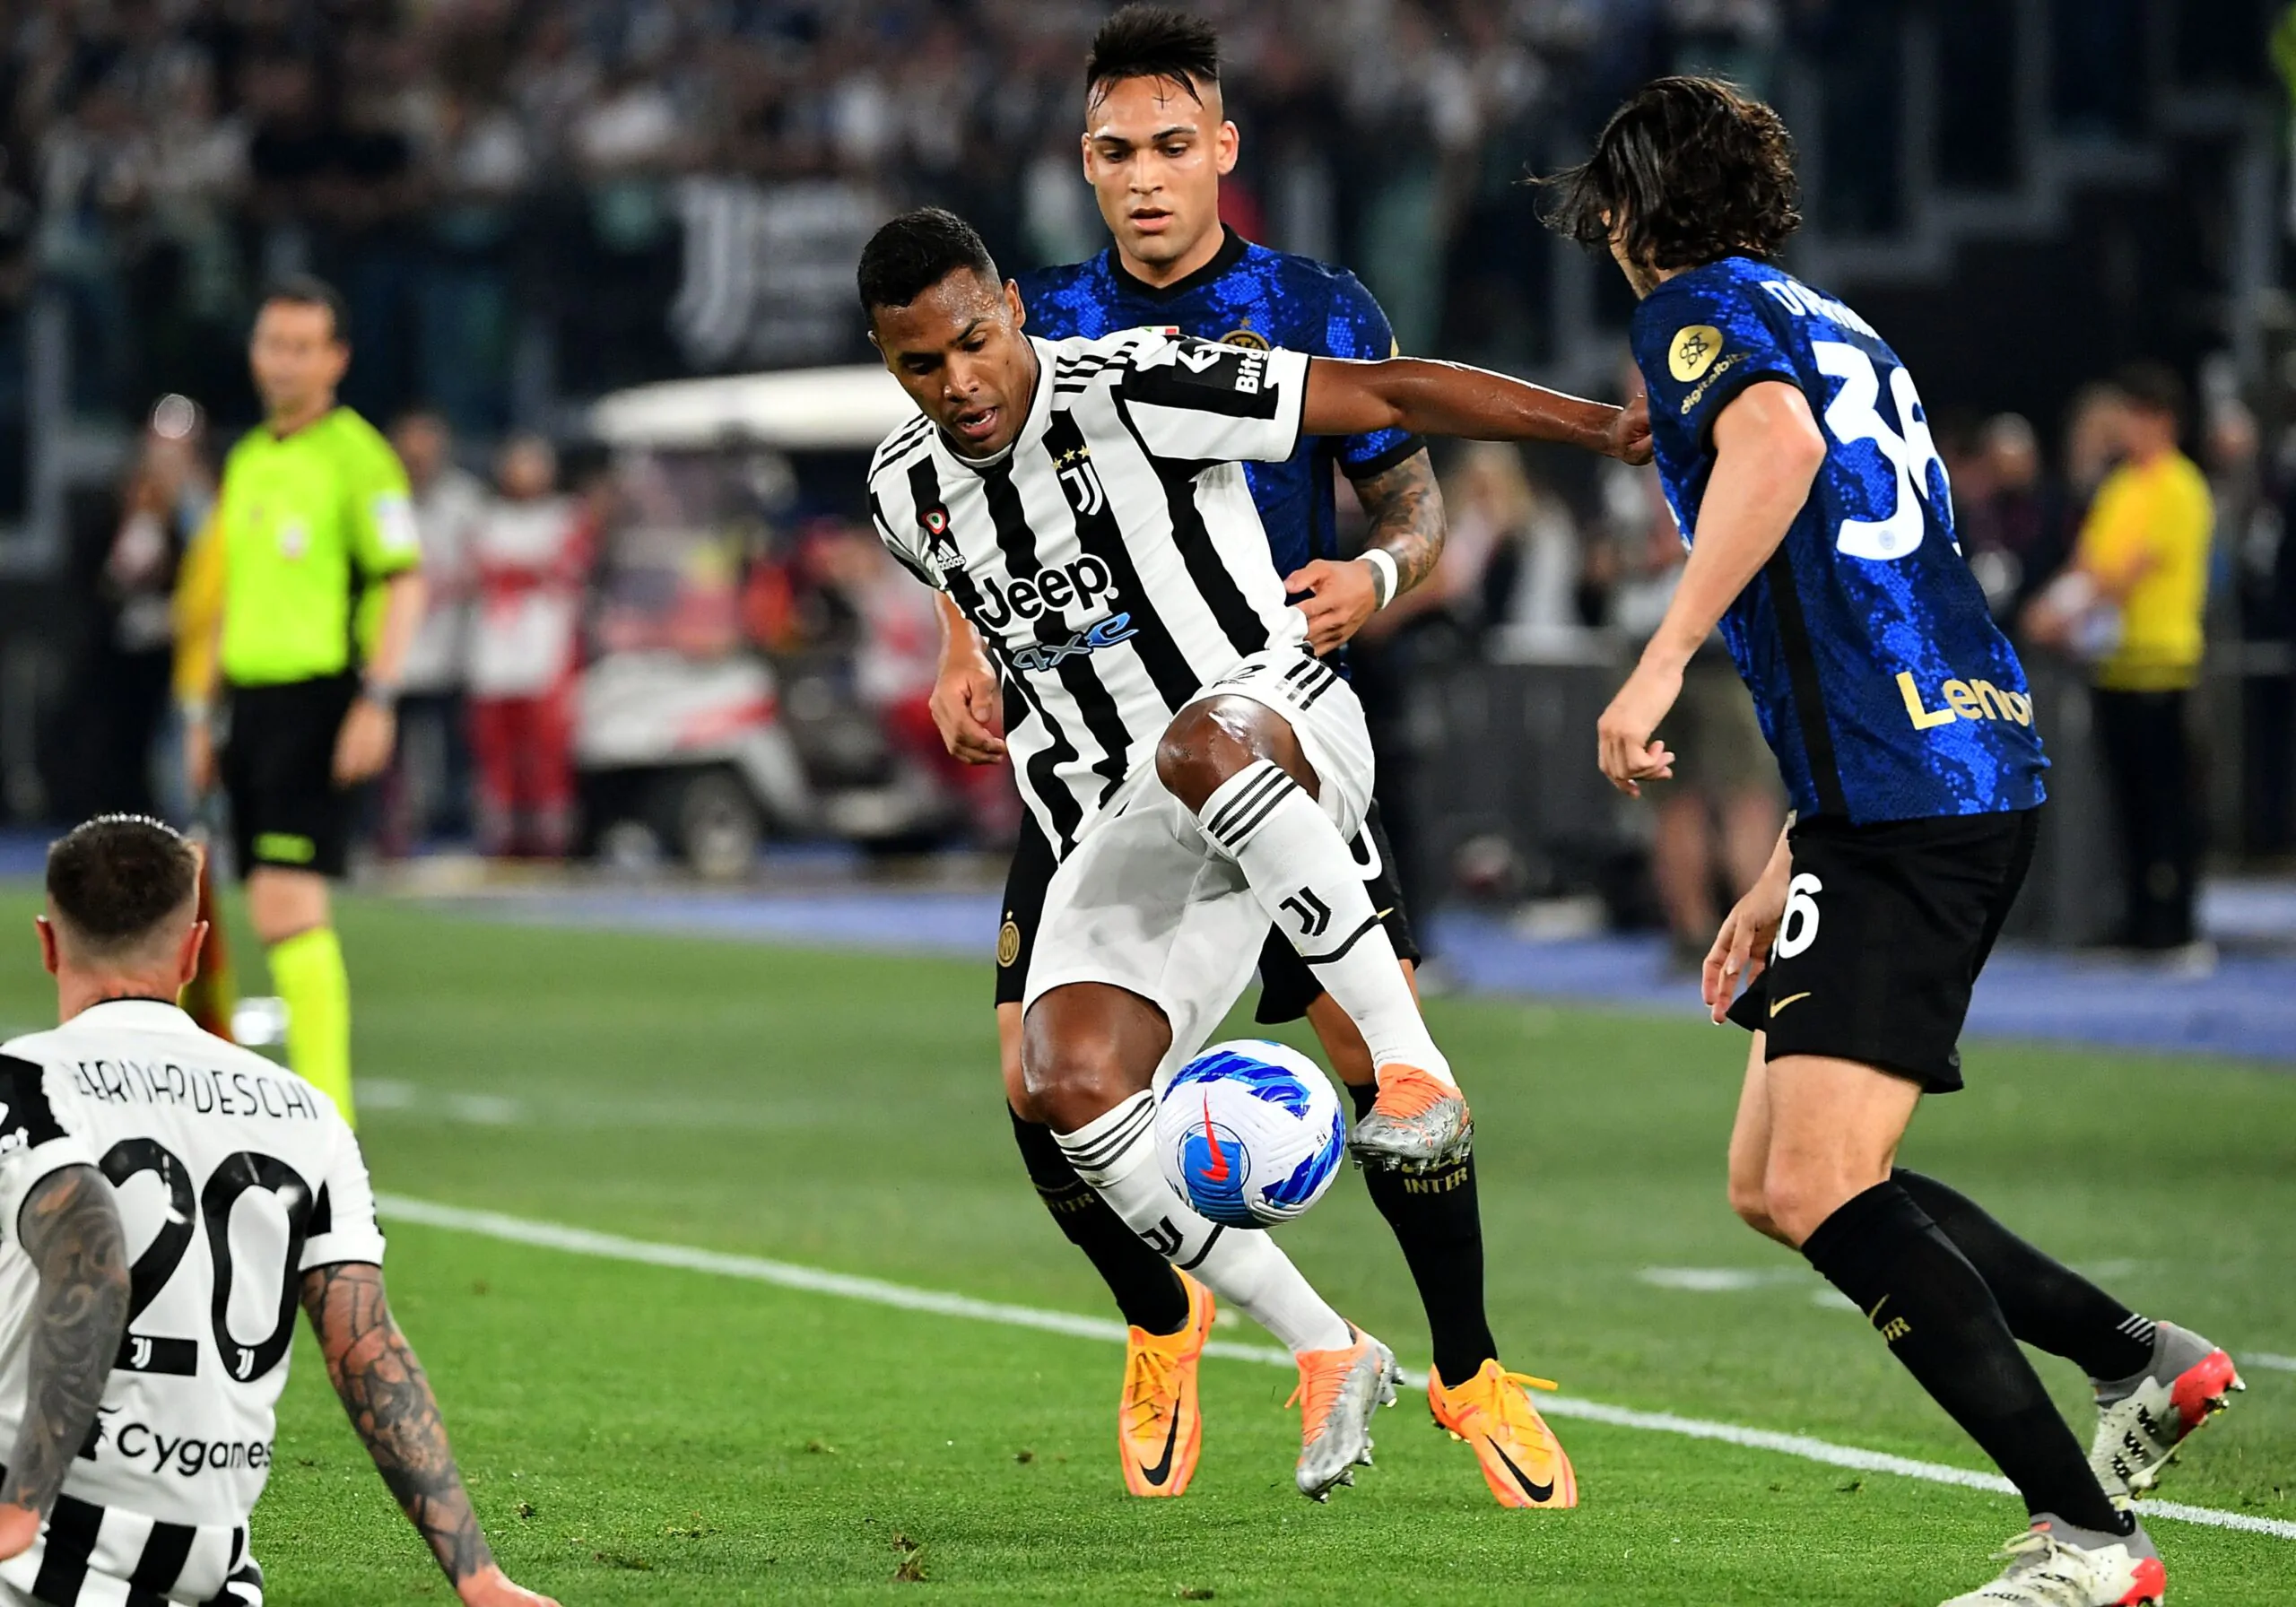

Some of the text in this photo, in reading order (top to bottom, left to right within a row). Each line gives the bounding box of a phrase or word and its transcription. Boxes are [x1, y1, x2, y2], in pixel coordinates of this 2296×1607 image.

[1811, 341, 1962, 560] 36
[976, 554, 1112, 631] Jeep
[1404, 1167, 1468, 1194] INTER
[99, 1137, 313, 1383] 20
